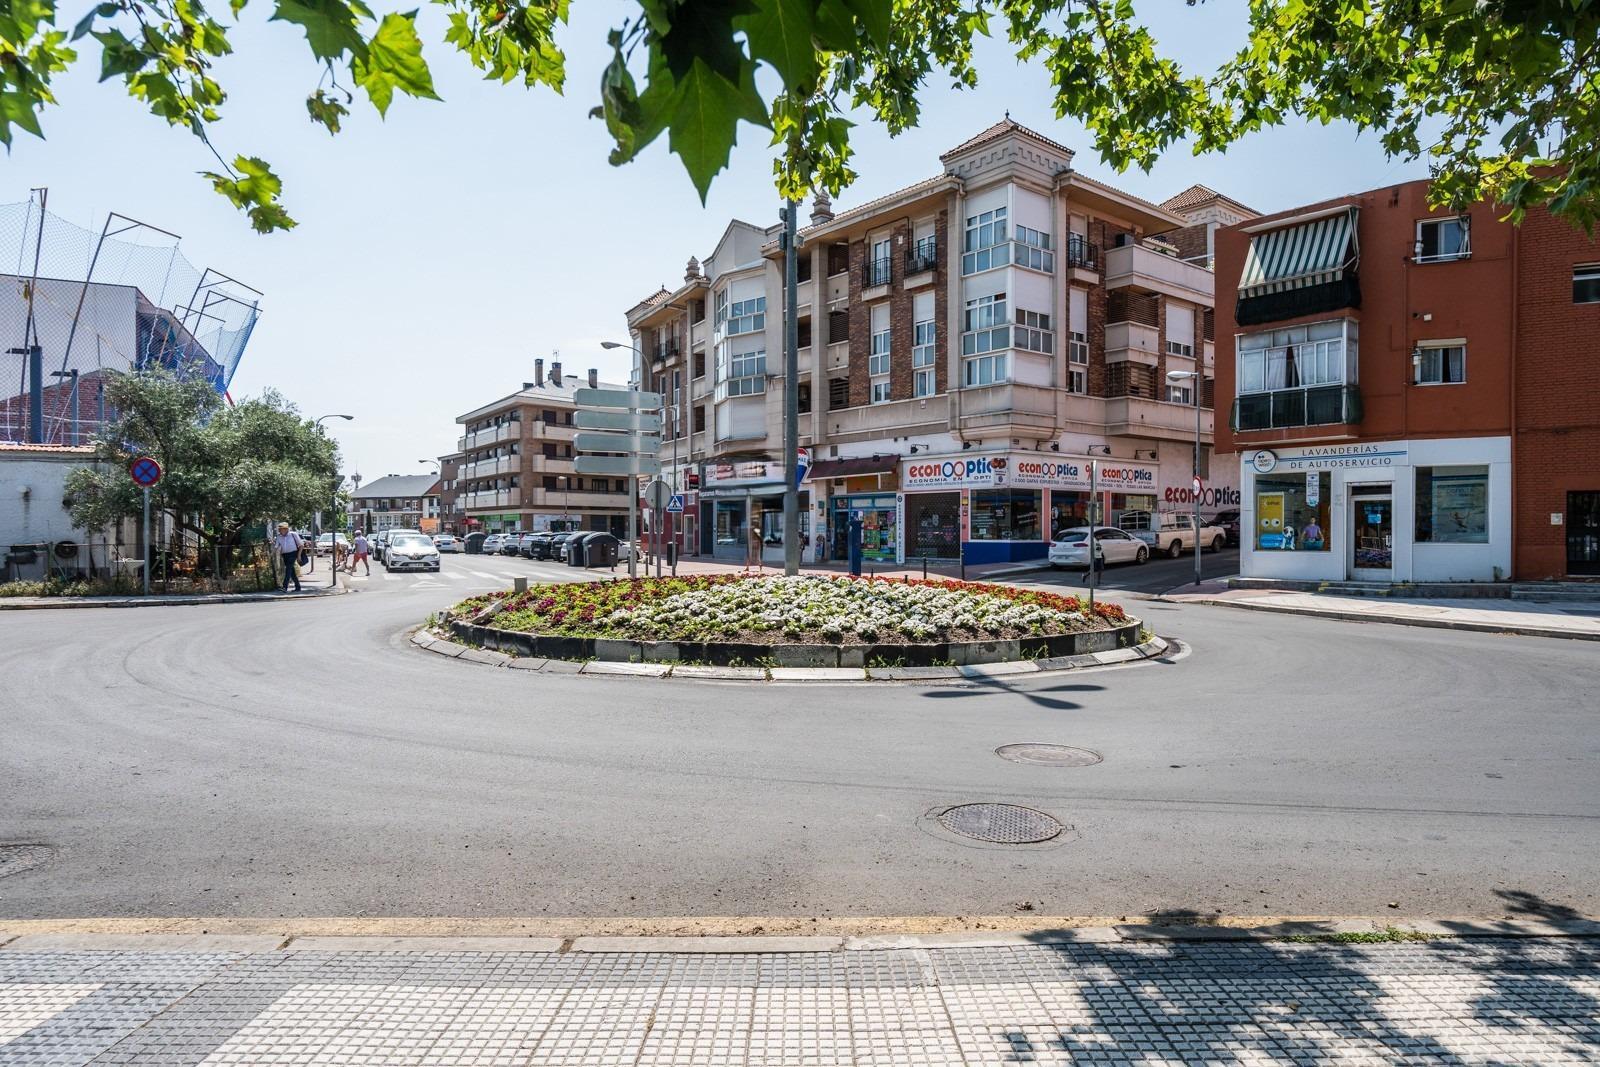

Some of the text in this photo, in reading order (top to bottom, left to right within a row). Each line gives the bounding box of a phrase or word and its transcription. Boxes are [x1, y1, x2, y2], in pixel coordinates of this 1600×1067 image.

[1302, 445, 1379, 457] LAVANDERÍAS
[1290, 457, 1392, 469] DE AUTOSERVICIO
